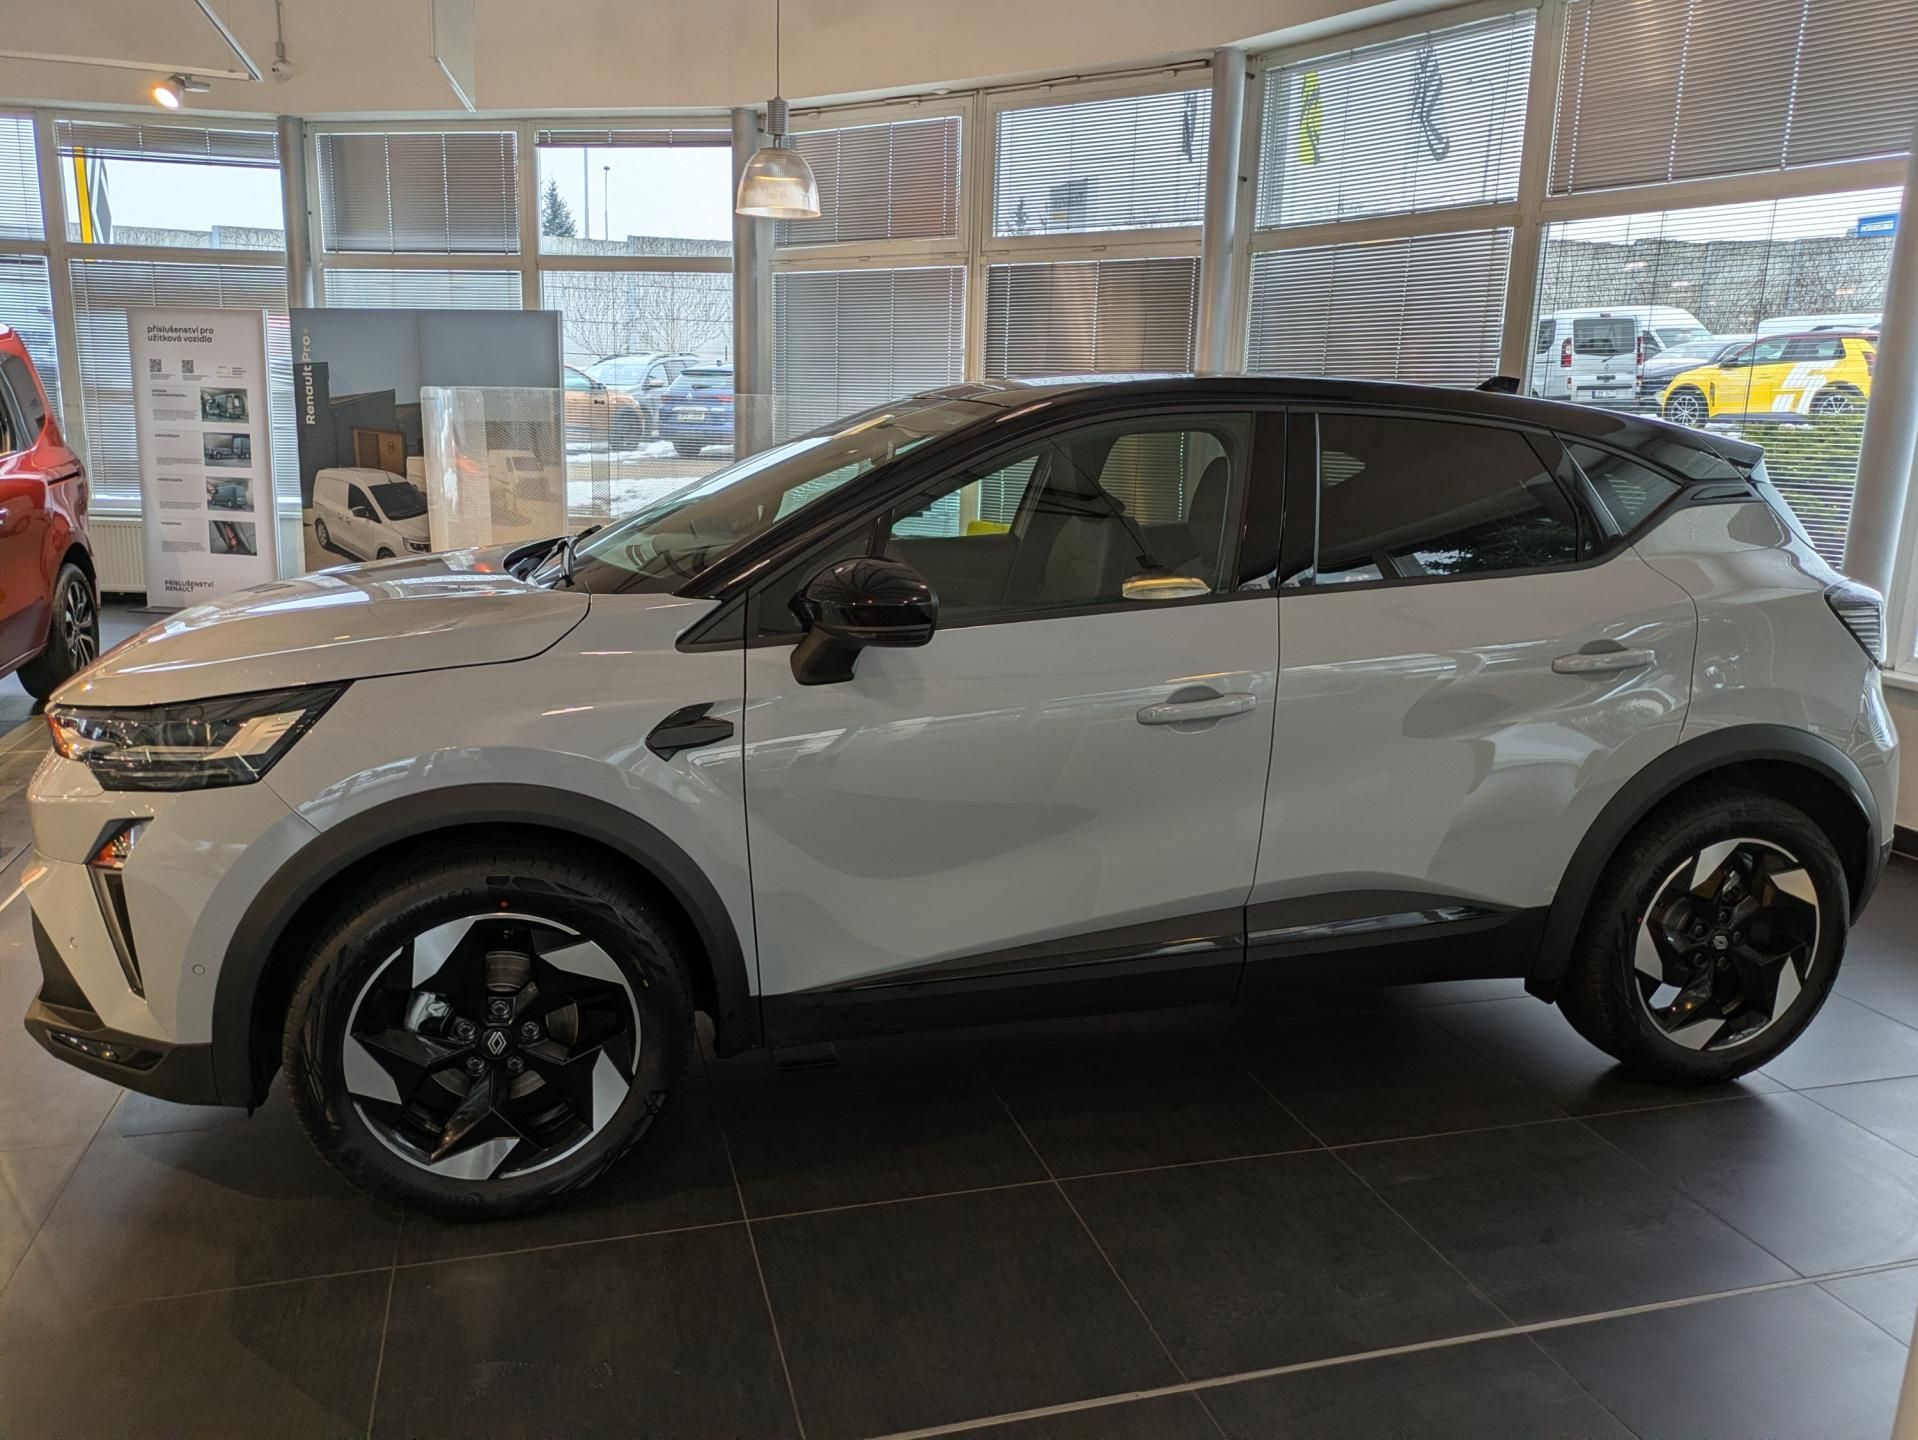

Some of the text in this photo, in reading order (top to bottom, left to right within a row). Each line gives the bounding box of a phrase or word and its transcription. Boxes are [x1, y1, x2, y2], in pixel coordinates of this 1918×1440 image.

[147, 325, 214, 336] příslušenství pro
[148, 334, 213, 343] užitková vozidla
[302, 365, 316, 425] Renault
[165, 579, 215, 588] PŘÍSLUŠENSTVÍ
[165, 585, 195, 593] RENAULT
